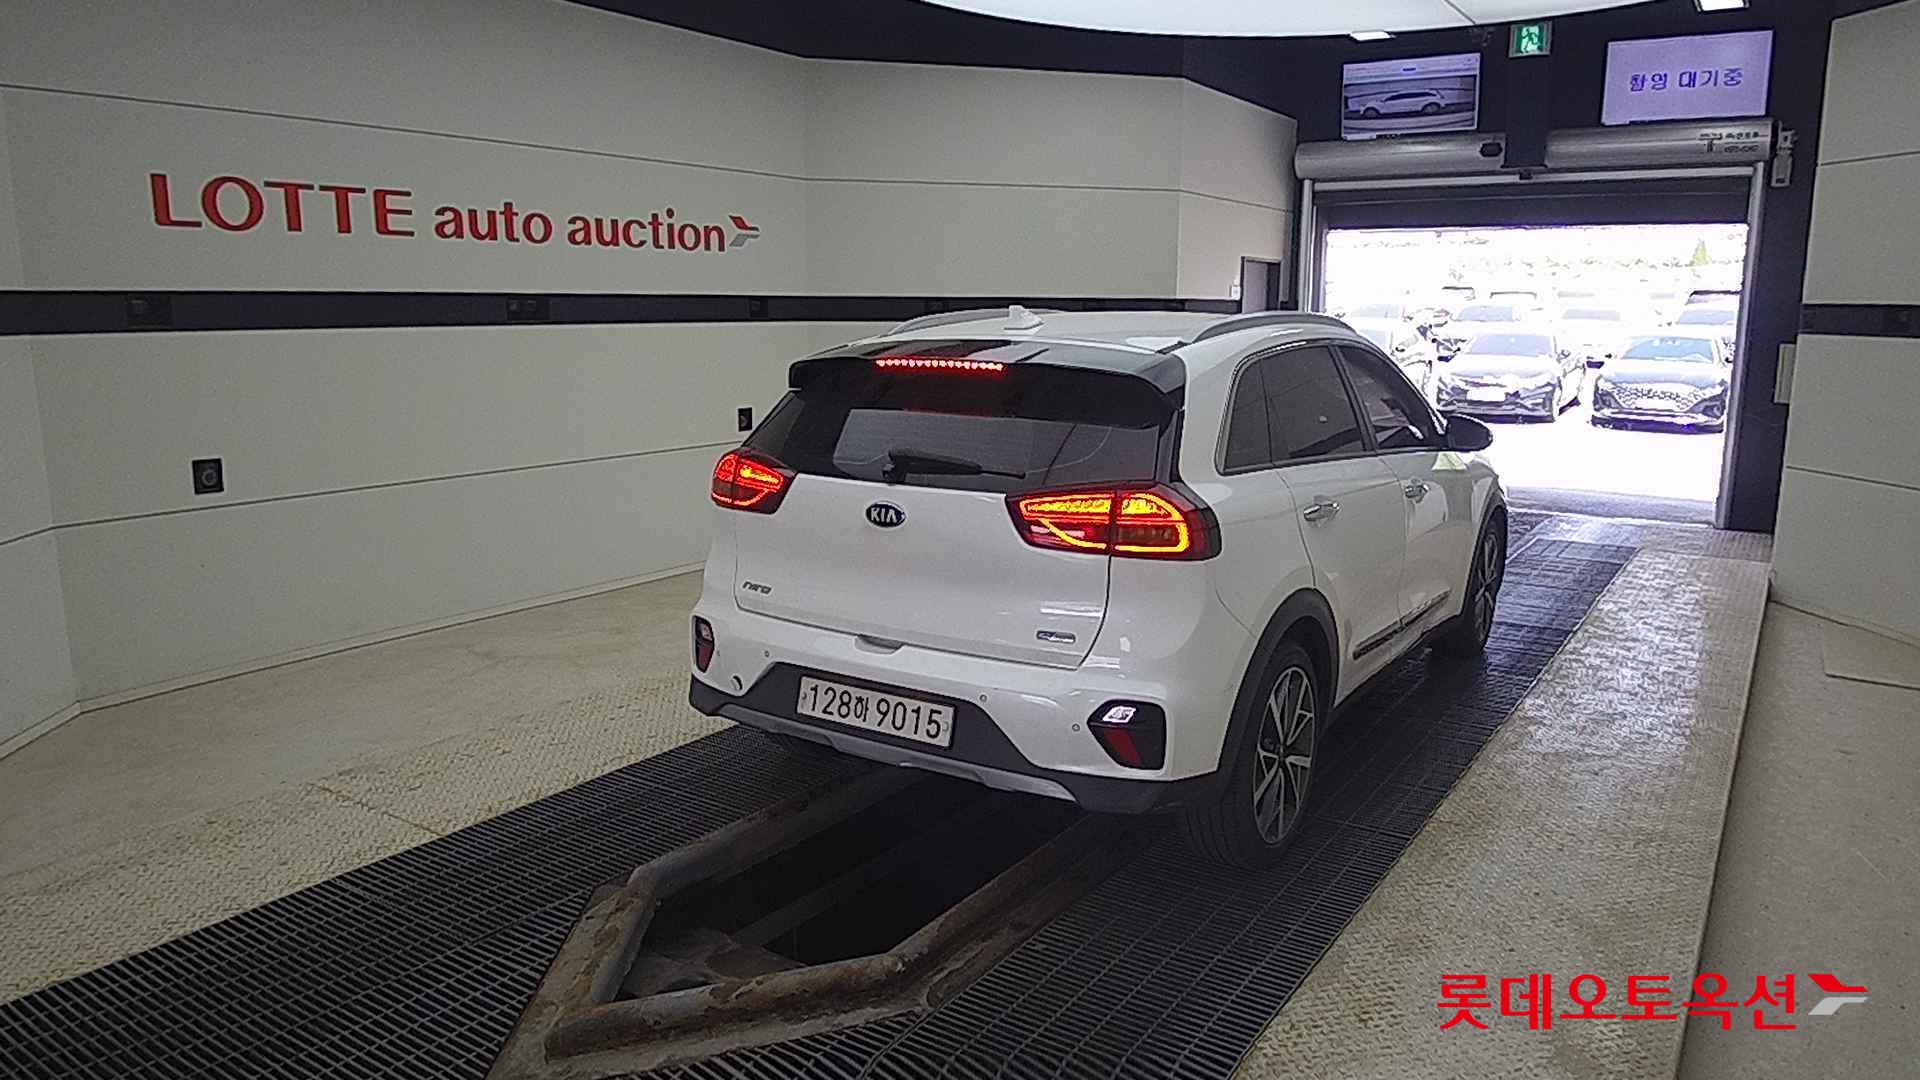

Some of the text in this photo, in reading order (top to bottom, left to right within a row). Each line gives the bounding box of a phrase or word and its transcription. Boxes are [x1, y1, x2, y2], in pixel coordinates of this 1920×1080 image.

[1678, 68, 1743, 89] 대기중
[150, 173, 726, 253] LOTTE auto auction
[871, 507, 898, 523] KIA
